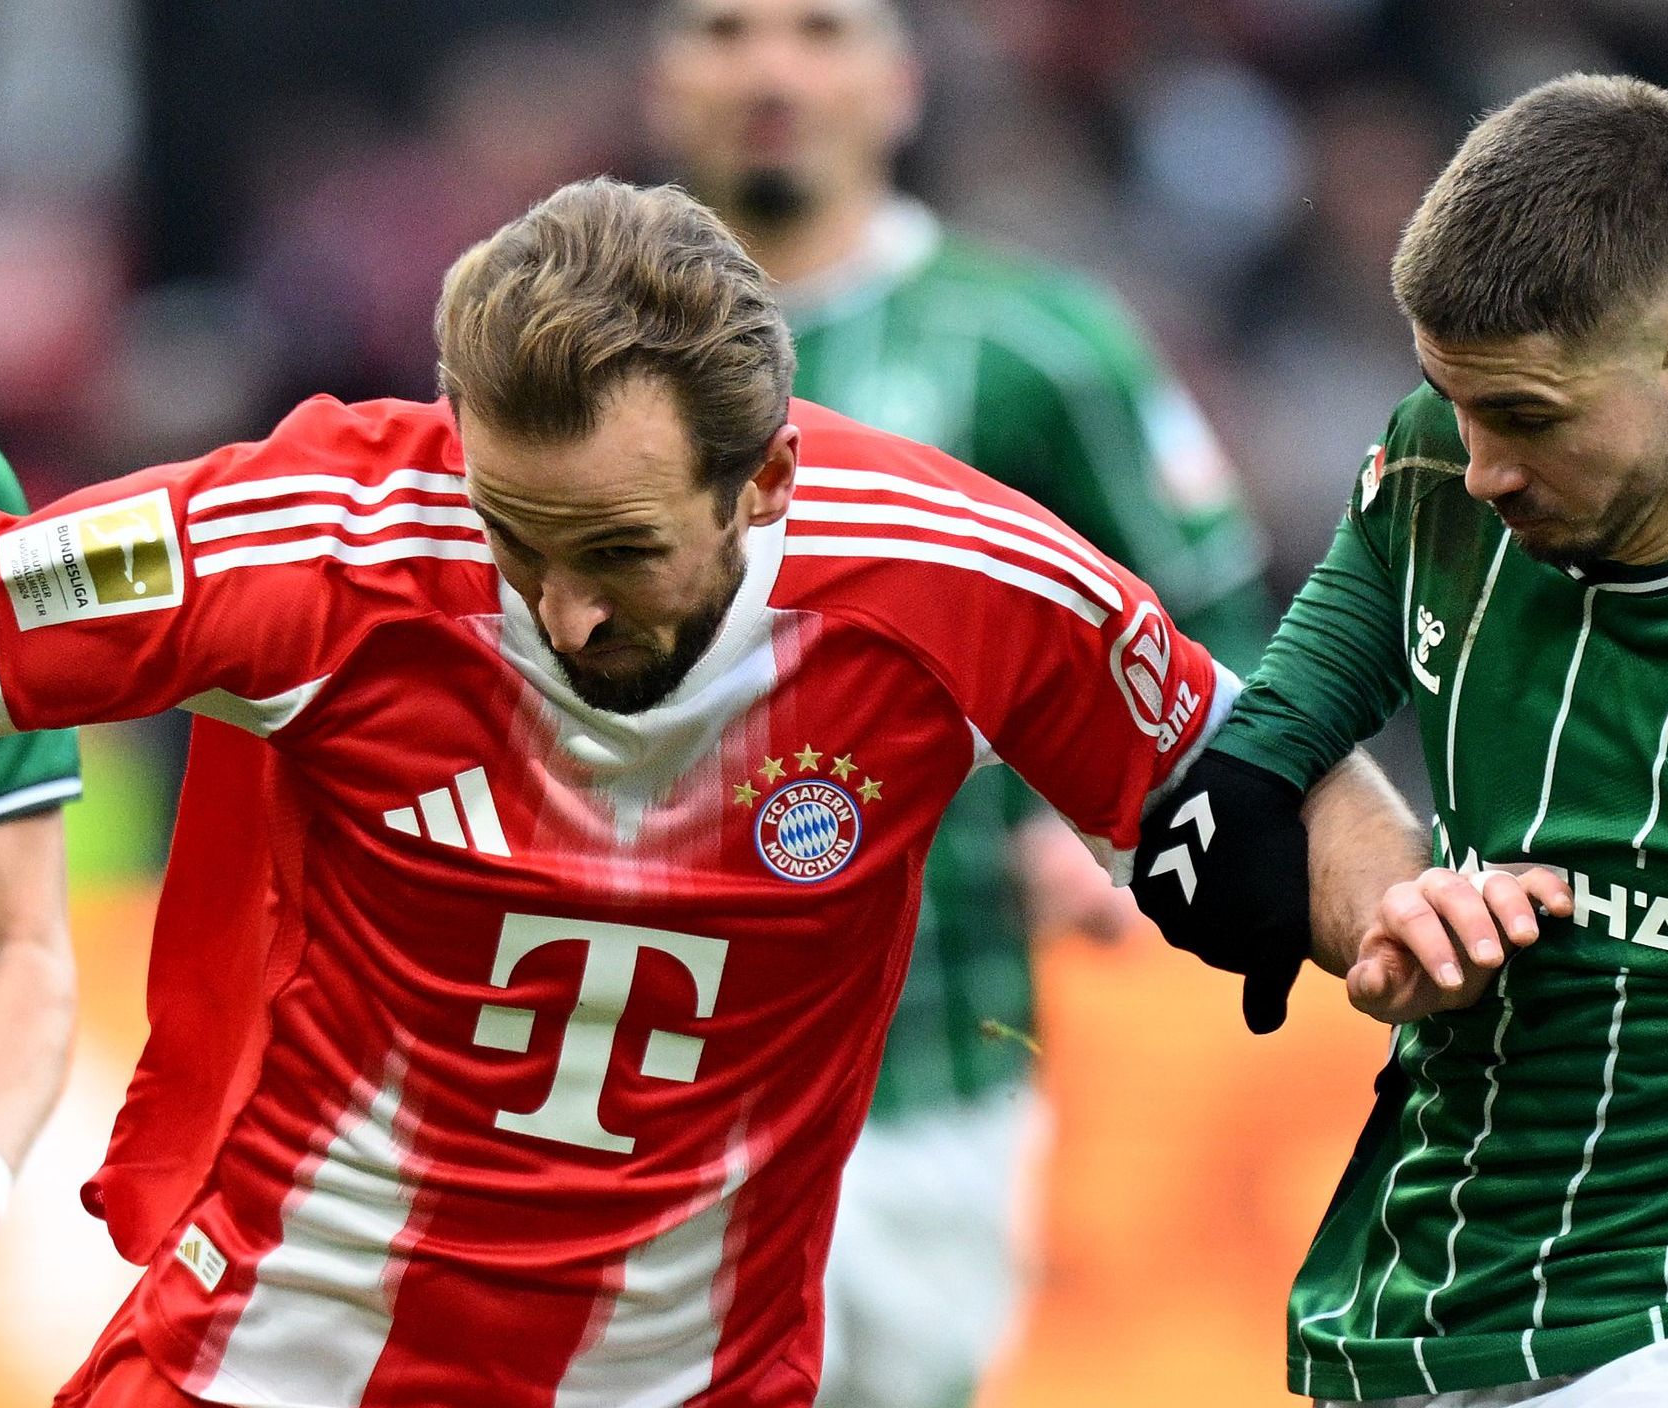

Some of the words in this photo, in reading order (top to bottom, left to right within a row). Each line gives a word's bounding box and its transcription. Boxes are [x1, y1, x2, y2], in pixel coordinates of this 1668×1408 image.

[57, 525, 89, 608] BUNDESLIGA
[765, 802, 785, 825] FC
[786, 787, 852, 822] BAYERN
